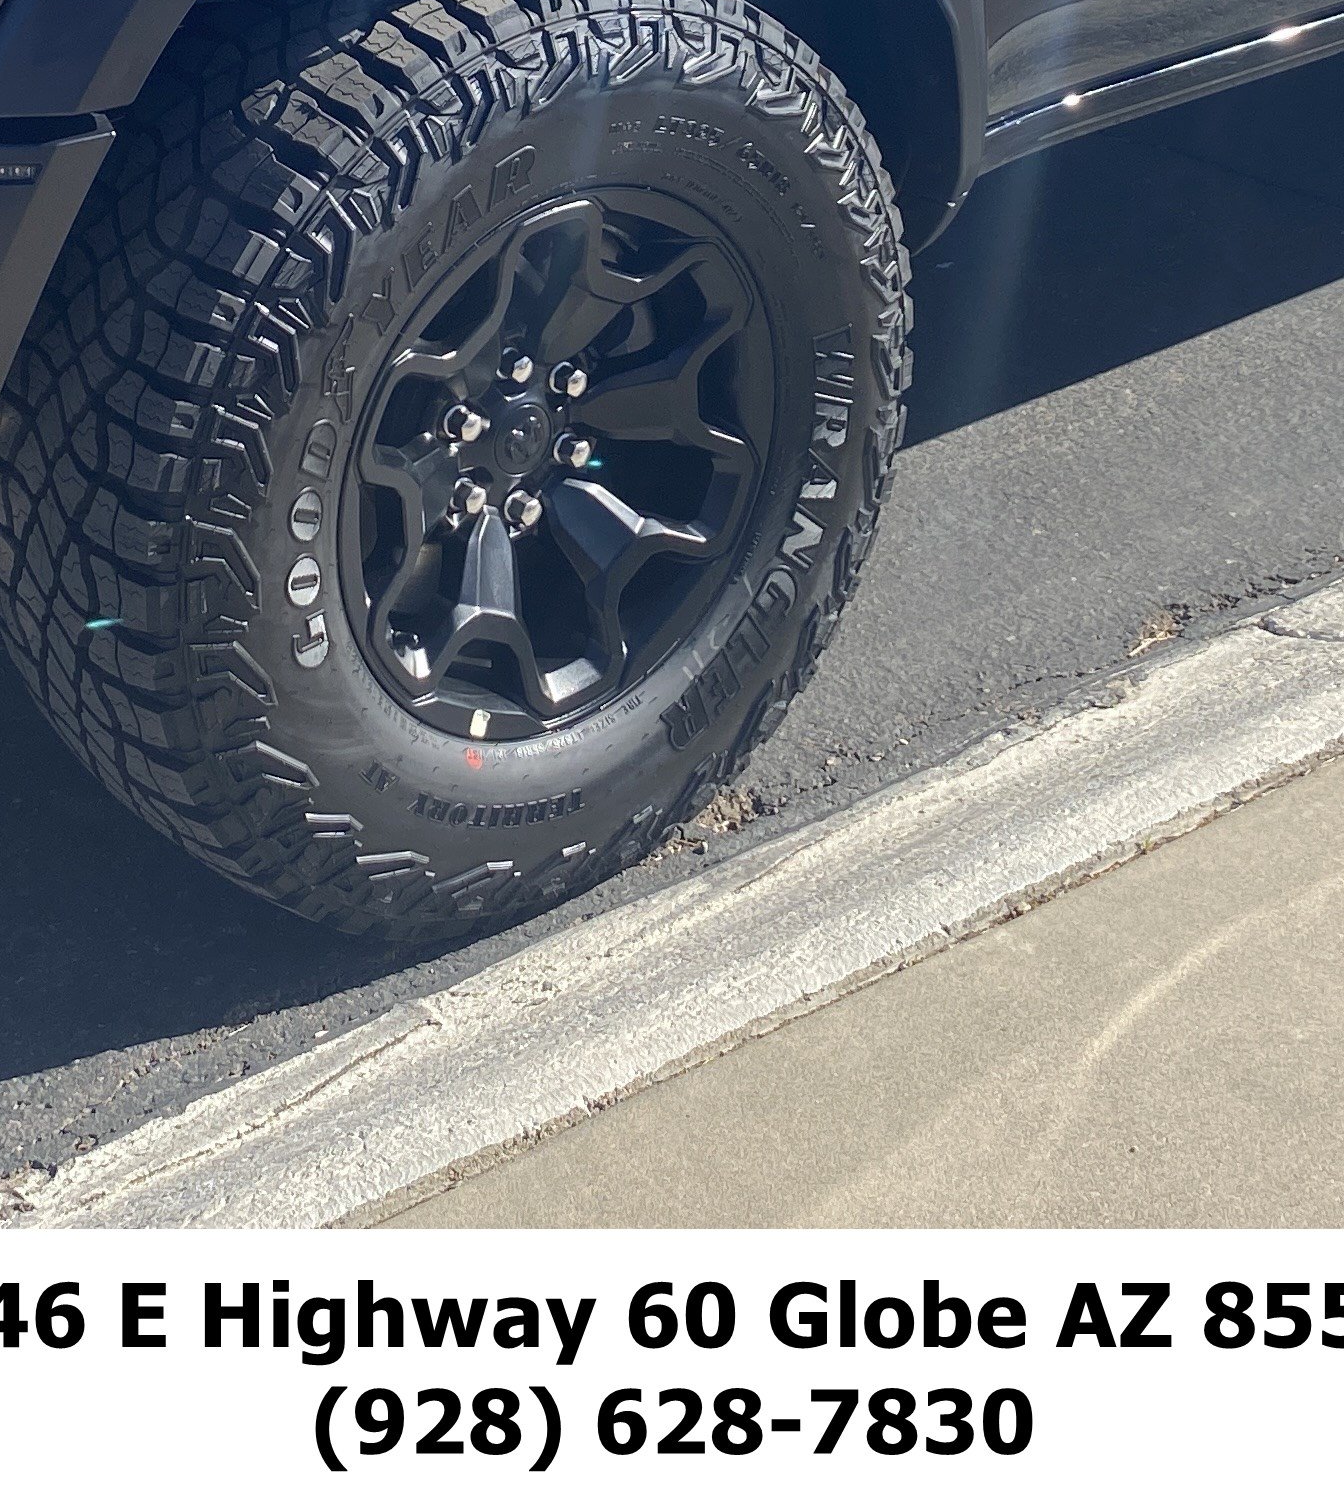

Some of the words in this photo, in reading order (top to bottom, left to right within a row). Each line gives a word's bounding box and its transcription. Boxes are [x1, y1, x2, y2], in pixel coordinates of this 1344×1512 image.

[660, 323, 855, 751] WRANGLER
[357, 759, 401, 795] AT
[405, 787, 587, 830] TERRITORY
